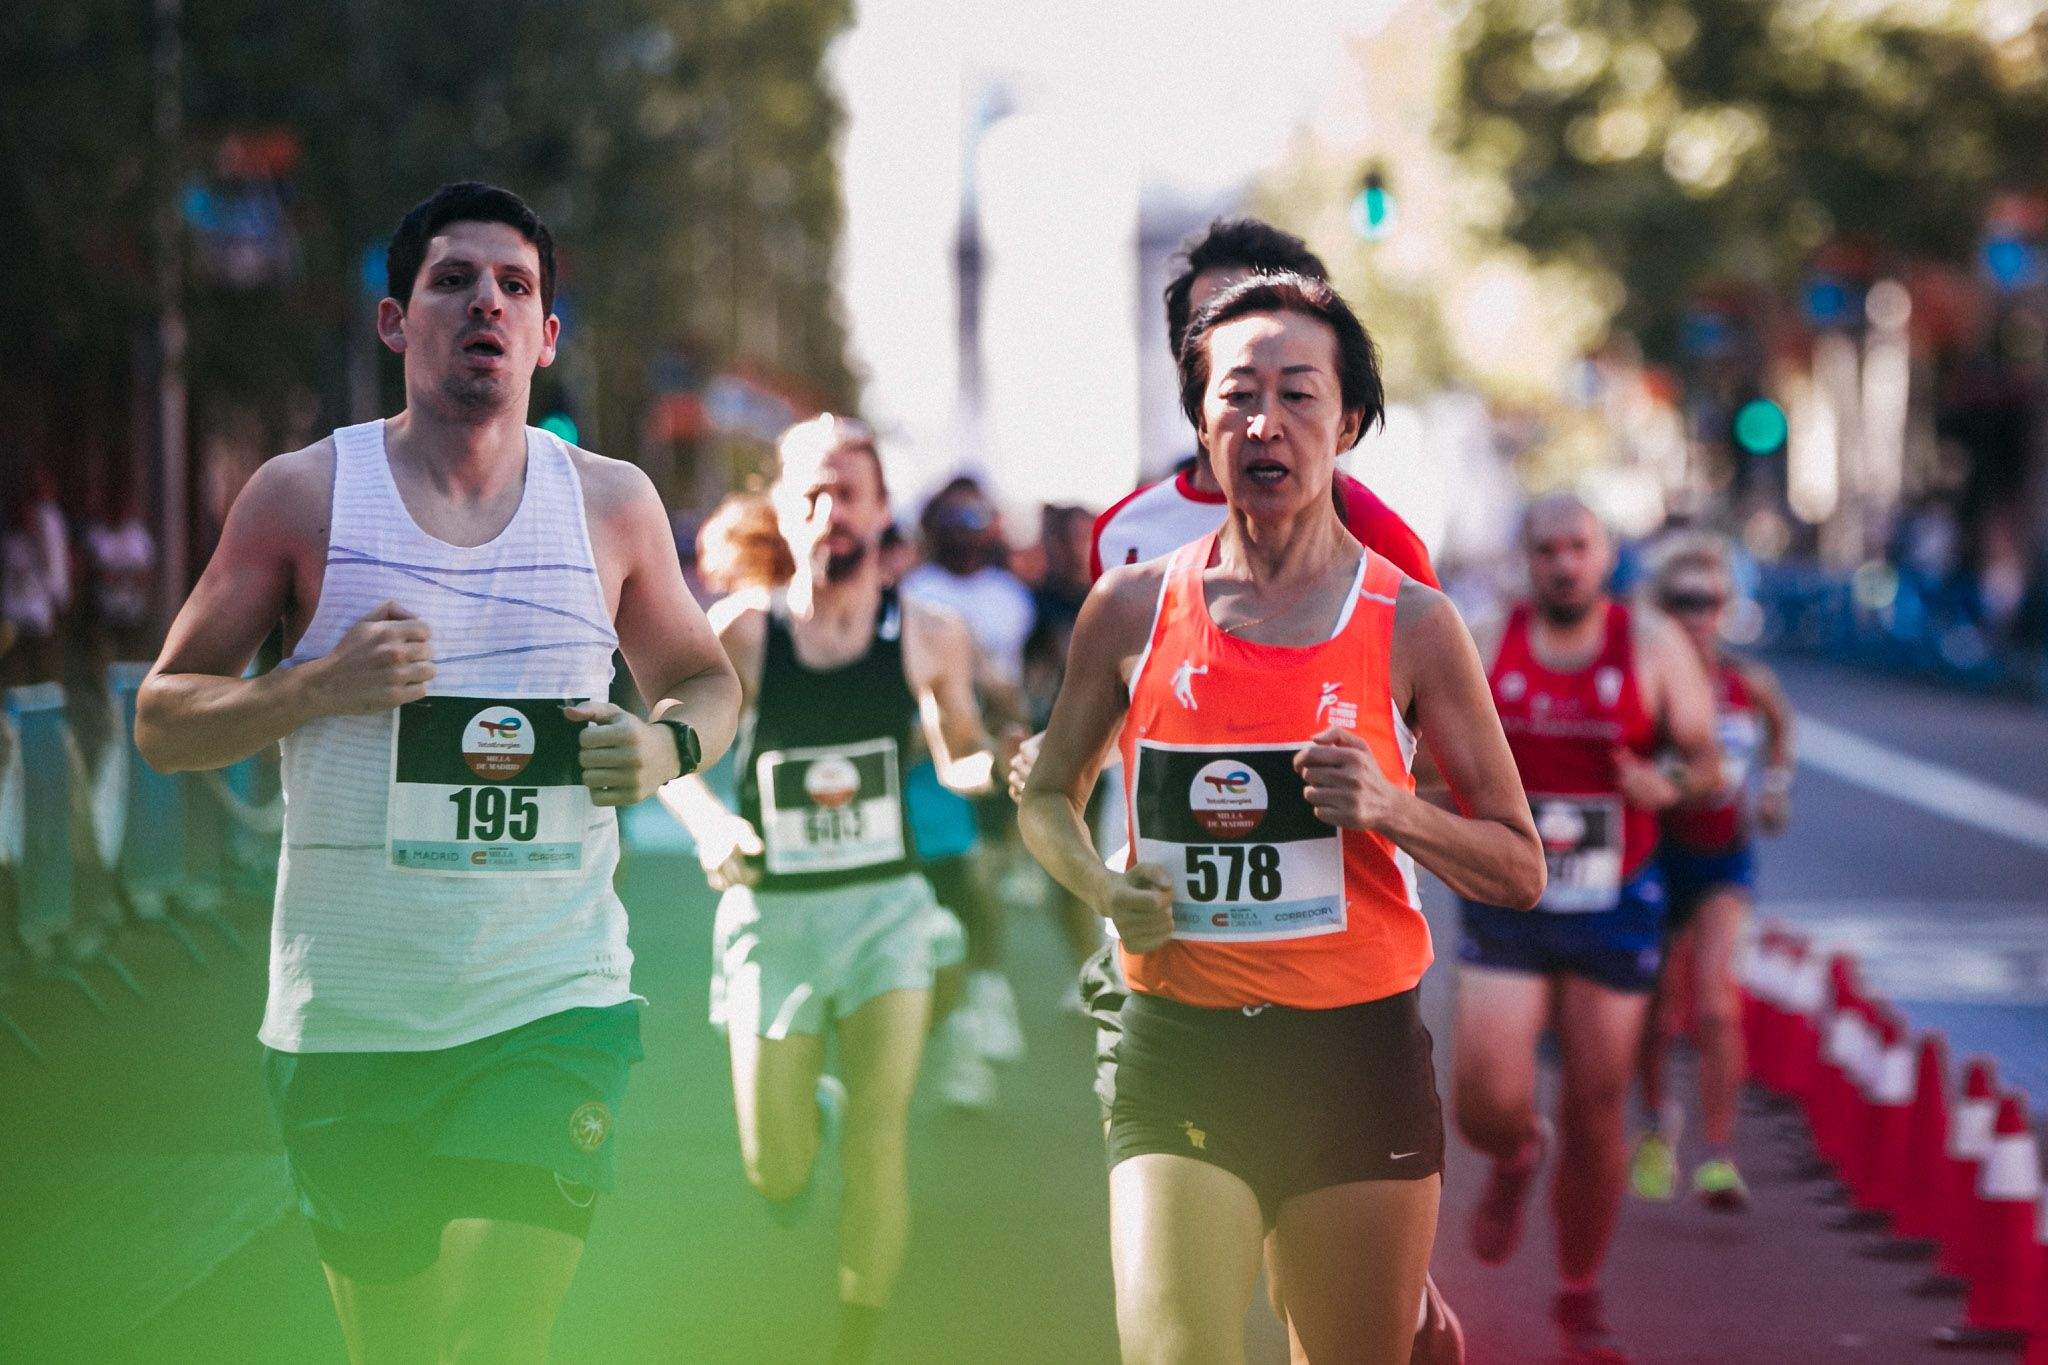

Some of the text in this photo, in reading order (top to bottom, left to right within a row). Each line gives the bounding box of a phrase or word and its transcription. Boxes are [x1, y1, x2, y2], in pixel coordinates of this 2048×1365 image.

[489, 763, 520, 771] MADRID
[449, 786, 539, 842] 195
[1220, 820, 1254, 828] MADRID
[412, 849, 460, 862] MADRID
[1185, 845, 1282, 902] 578
